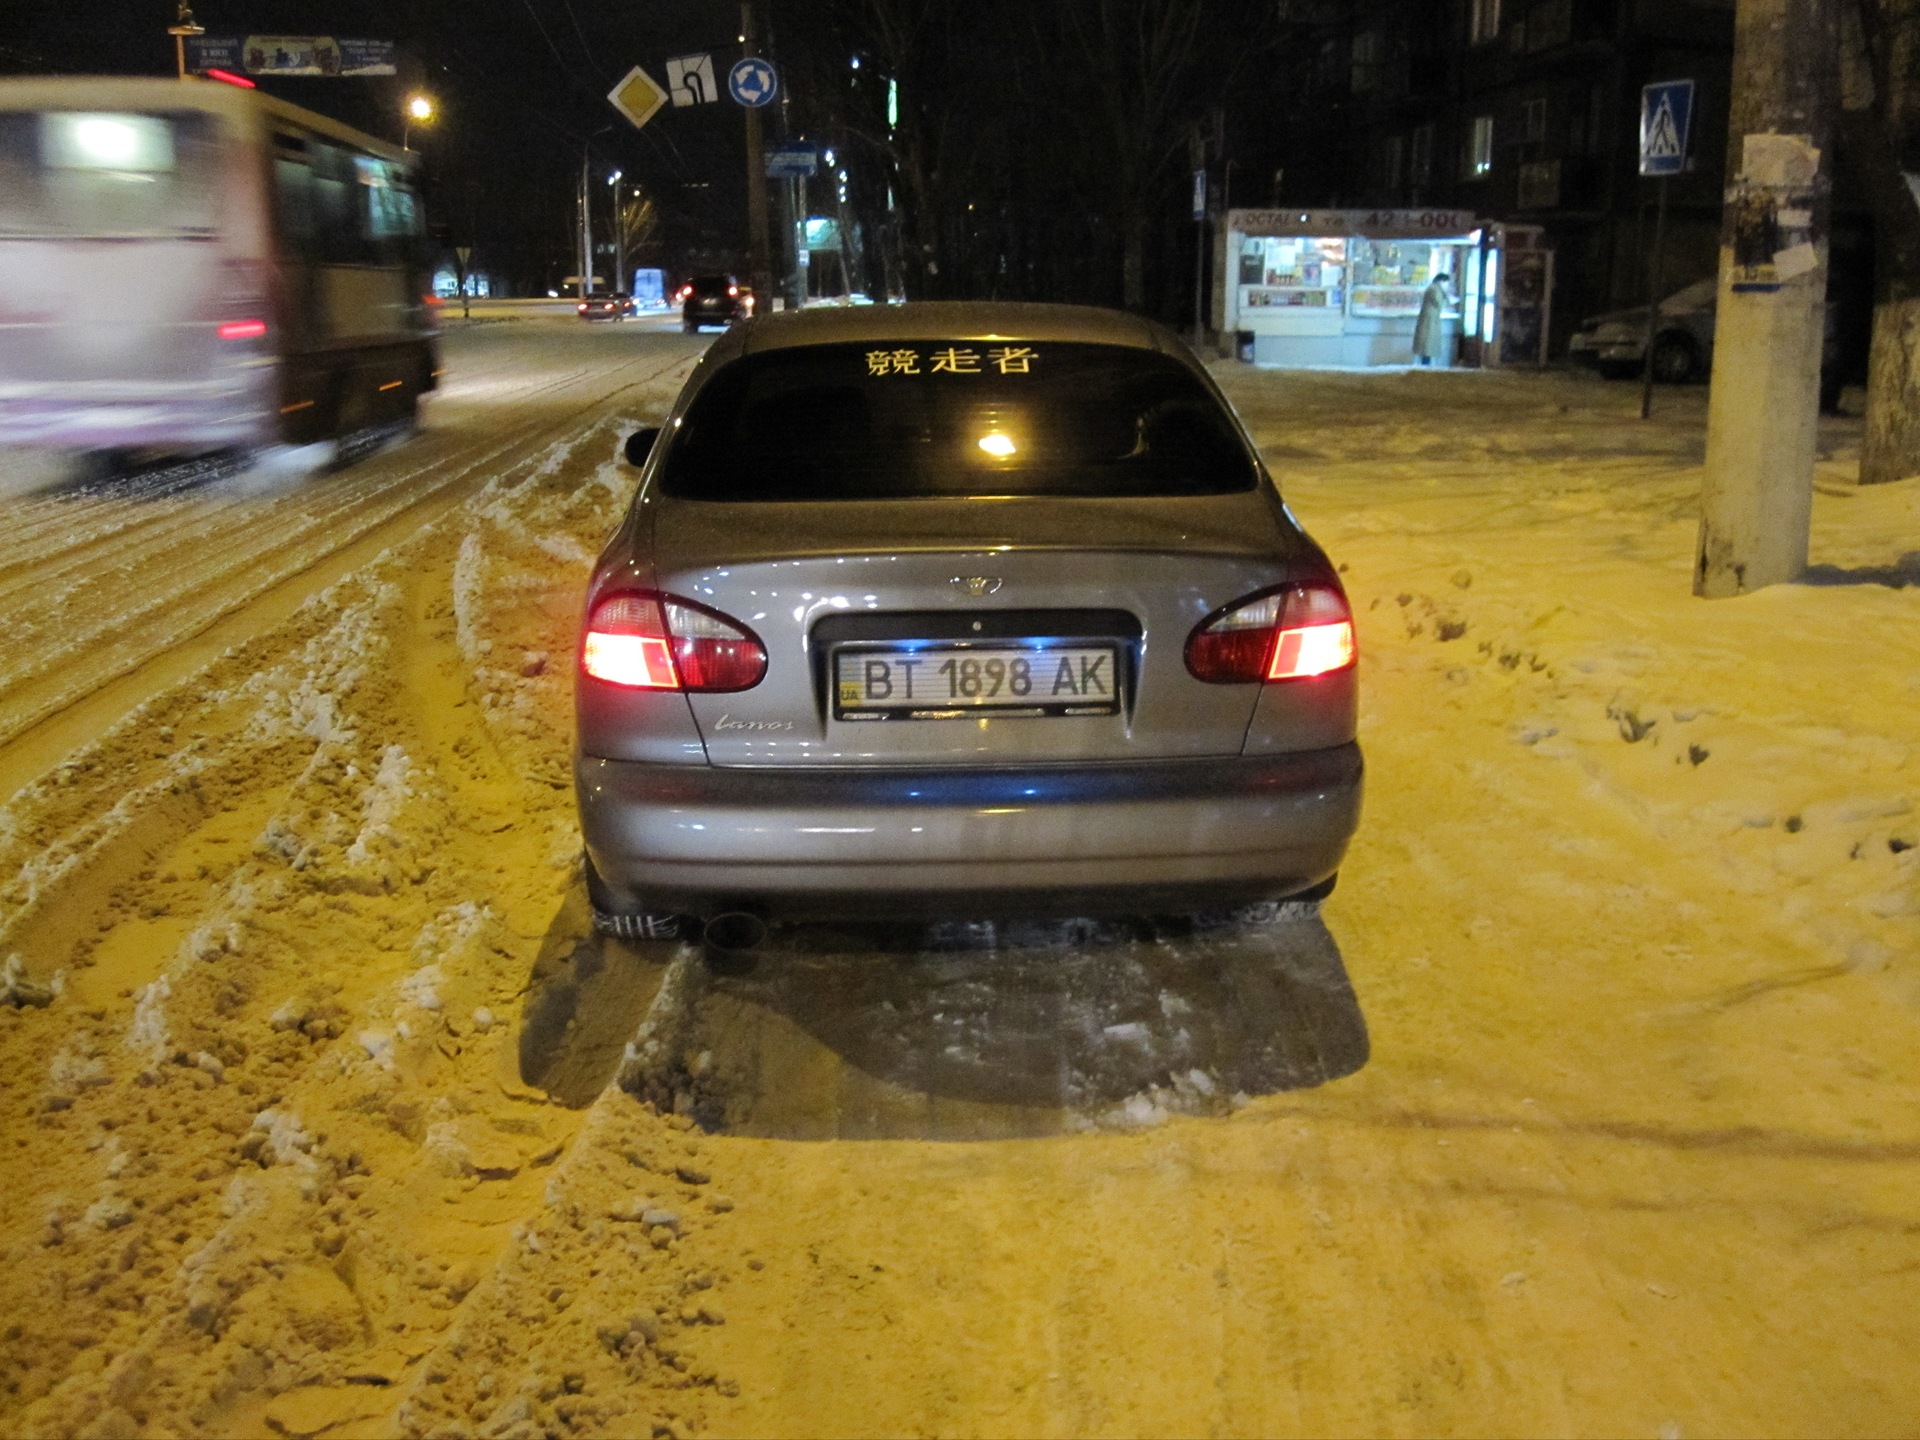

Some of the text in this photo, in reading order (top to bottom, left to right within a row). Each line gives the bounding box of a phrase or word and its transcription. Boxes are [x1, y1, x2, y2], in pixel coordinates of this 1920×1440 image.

[865, 655, 1108, 700] BT 1898 AK
[841, 690, 859, 701] UA
